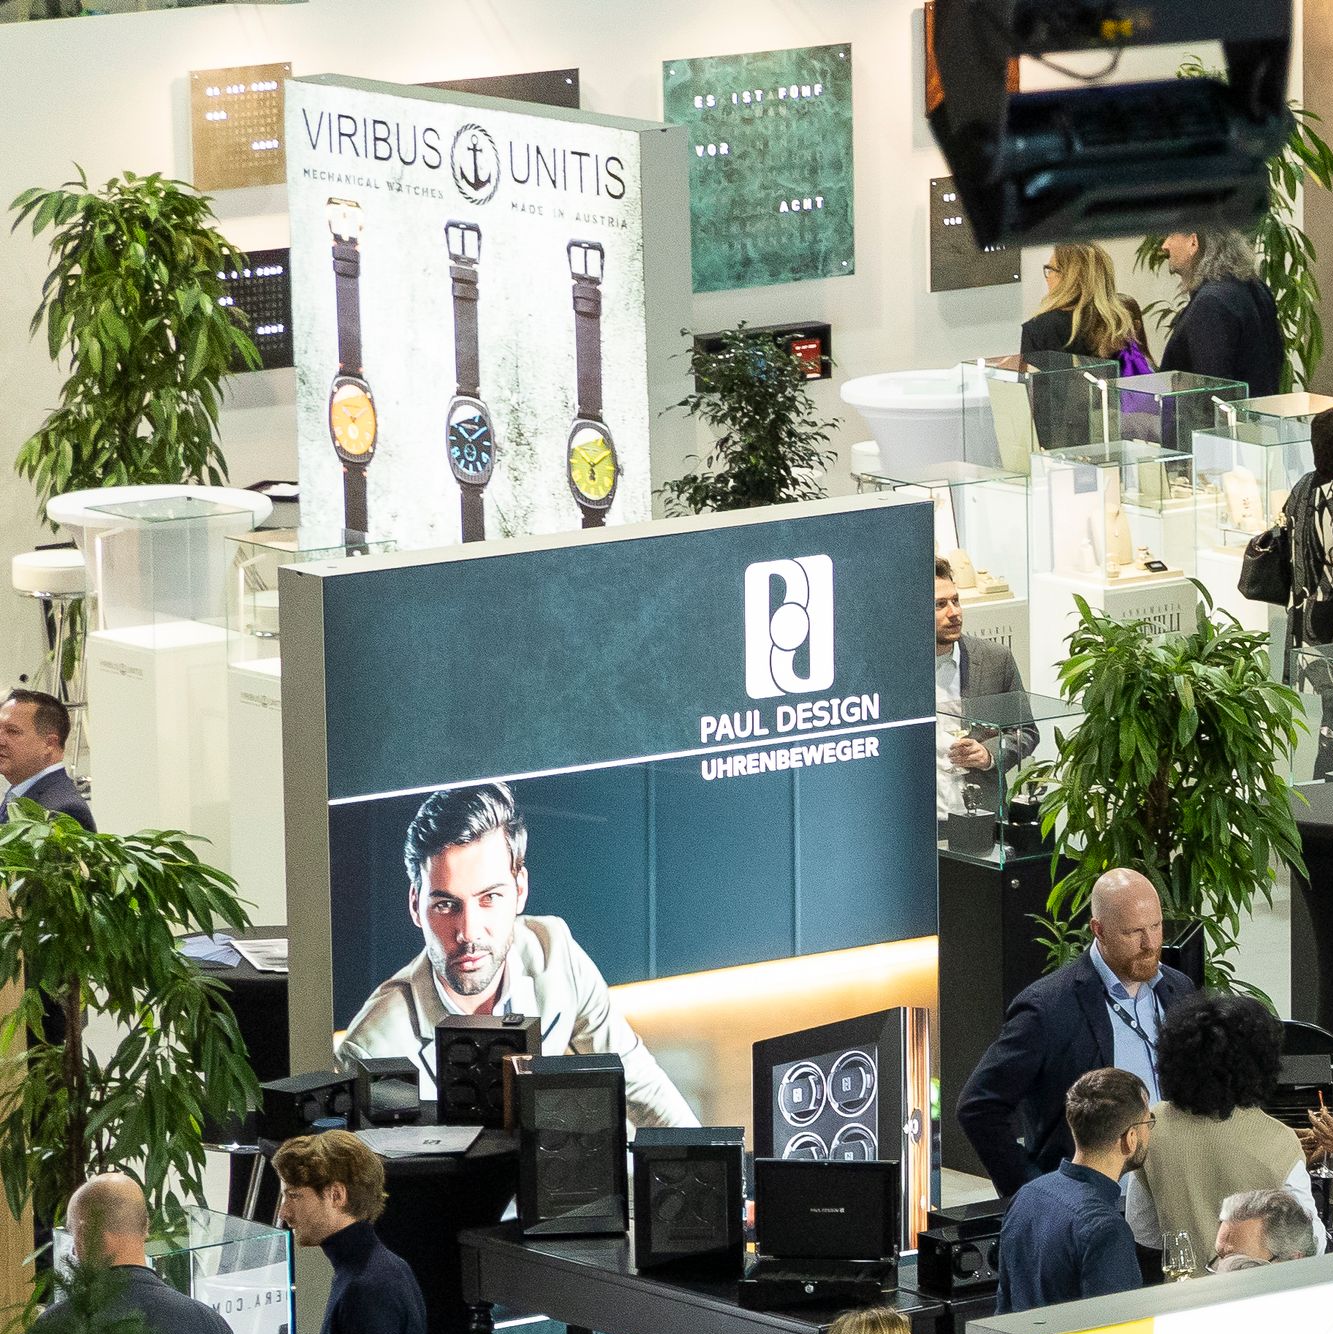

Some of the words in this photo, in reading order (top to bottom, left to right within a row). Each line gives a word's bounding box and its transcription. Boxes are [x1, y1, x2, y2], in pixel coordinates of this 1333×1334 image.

[302, 107, 443, 170] VIRIBUS
[509, 140, 627, 200] UNITIS
[694, 141, 730, 158] VOR
[303, 167, 380, 190] MECHANICAL
[386, 180, 445, 200] WATCHES
[511, 201, 544, 216] MADE
[575, 212, 629, 230] AUSTRIA
[700, 708, 770, 744] PAUL
[776, 692, 881, 734] DESIGN
[700, 736, 881, 782] UHRENBEWEGER
